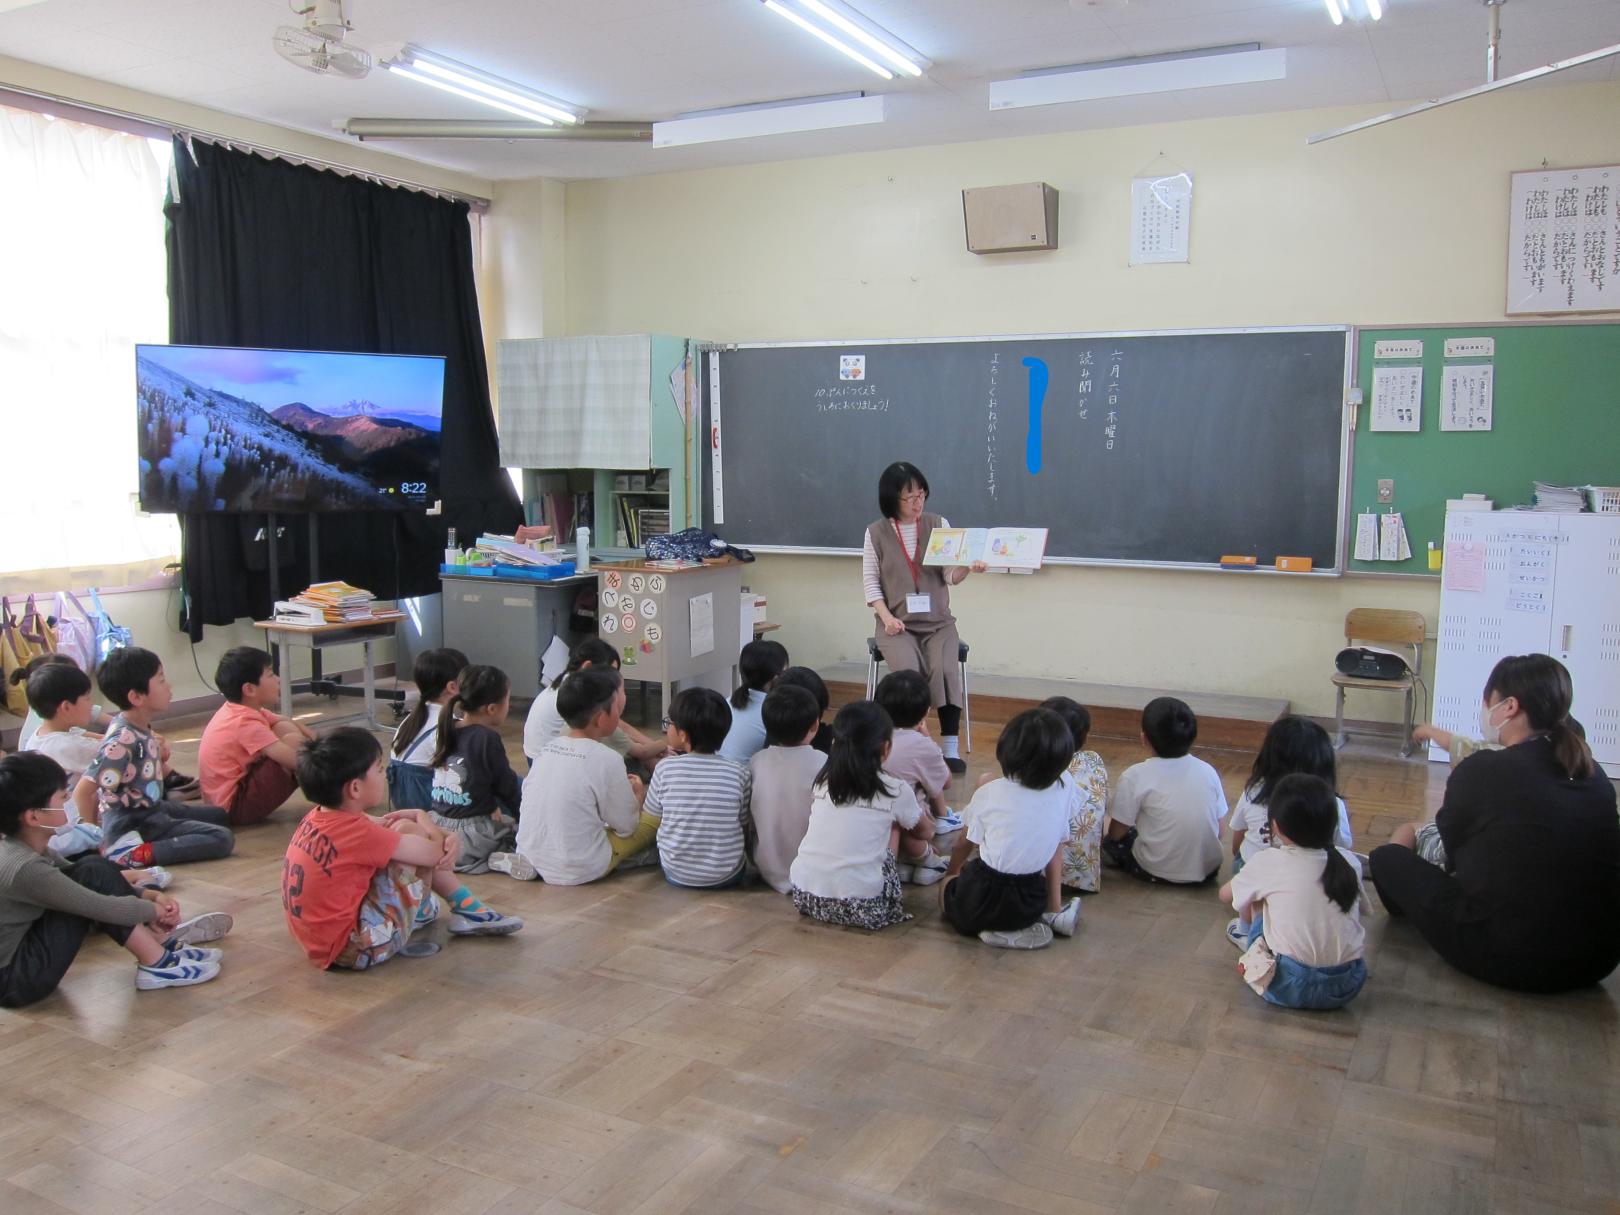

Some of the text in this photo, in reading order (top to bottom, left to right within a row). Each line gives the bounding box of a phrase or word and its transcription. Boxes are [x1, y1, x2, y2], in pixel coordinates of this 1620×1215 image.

[1078, 351, 1095, 420] 読み聞かせ
[401, 482, 427, 494] 8:22
[647, 627, 659, 640] も
